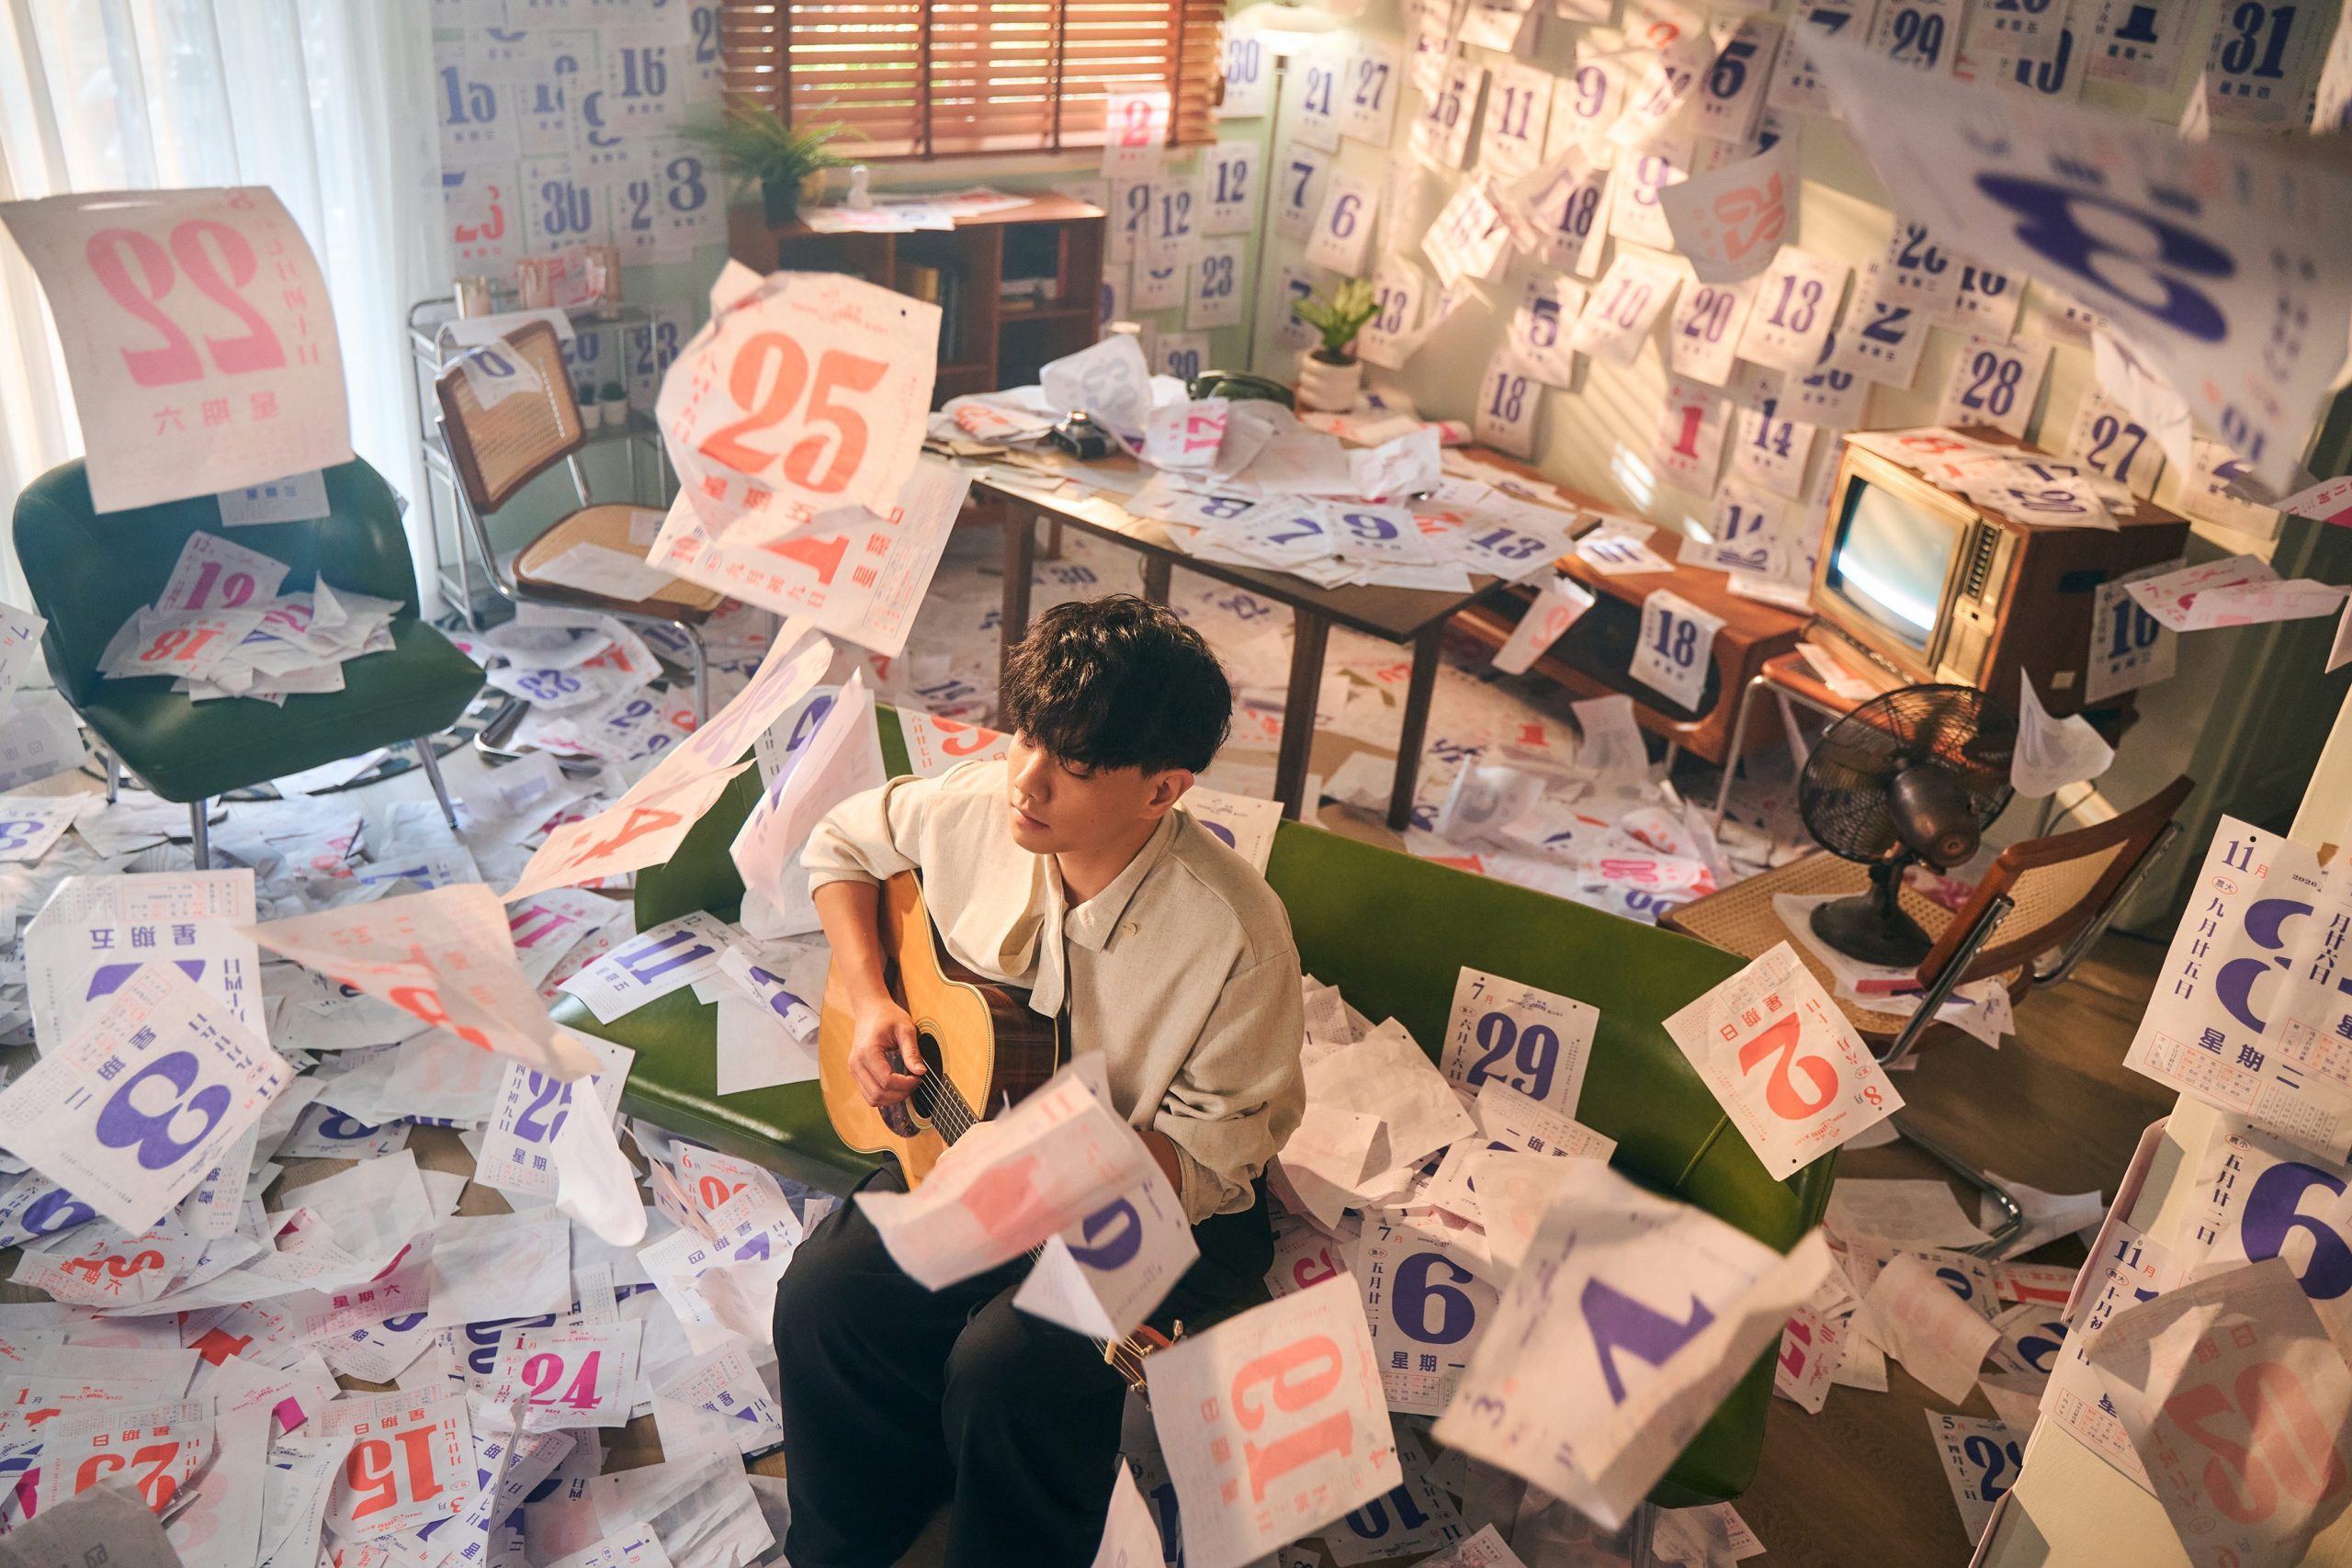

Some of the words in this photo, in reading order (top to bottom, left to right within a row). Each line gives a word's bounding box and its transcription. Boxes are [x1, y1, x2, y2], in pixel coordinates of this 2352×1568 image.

[691, 7, 721, 63] 2
[1889, 7, 1944, 69] 29
[2222, 2, 2296, 79] 31
[1227, 39, 1259, 84] 30
[1356, 60, 1389, 111] 27
[1710, 41, 1756, 99] 5
[1306, 68, 1332, 115] 21
[1499, 87, 1533, 141] 11
[1577, 66, 1606, 117] 9
[1122, 101, 1152, 148] 2
[1216, 161, 1247, 203] 12
[1291, 162, 1314, 207] 7
[1634, 156, 1669, 206] 9
[1161, 191, 1191, 238] 12
[1330, 193, 1363, 238] 6
[1559, 187, 1598, 236] 18
[1201, 255, 1233, 299] 23
[1374, 288, 1406, 333] 13
[1530, 299, 1560, 346] 5
[1602, 279, 1652, 330] 10
[1685, 288, 1735, 342] 20
[1769, 276, 1824, 333] 13
[1490, 374, 1526, 423] 18
[1962, 352, 2023, 416] 28
[697, 332, 889, 495] 25
[1672, 405, 1704, 459] 1
[1755, 398, 1792, 457] 14
[2087, 415, 2147, 482] 27
[1267, 518, 1324, 545] 7
[1342, 513, 1398, 540] 9
[1472, 528, 1546, 560] 13
[184, 561, 254, 610] 19
[140, 627, 224, 662] 18
[1655, 610, 1698, 667] 18
[2222, 840, 2269, 878] 11月
[2291, 874, 2318, 888] 2026
[90, 924, 198, 950] 星期五
[614, 931, 715, 986] 11
[2175, 897, 2224, 999] 九月廿五日
[2309, 912, 2350, 986] 月廿六日
[1472, 983, 1493, 1004] 7月
[1720, 993, 1783, 1042] 星期日
[187, 1011, 254, 1073] 九月廿五日
[1450, 1019, 1472, 1080] 六月十六日
[1467, 1011, 1559, 1101] 29
[1805, 999, 1857, 1066] 六月十日
[64, 1025, 157, 1111] 星期二
[1738, 1011, 1838, 1121] 2
[2198, 1027, 2304, 1090] 星期二
[96, 1052, 232, 1170] 3
[243, 1076, 279, 1109] 11月
[500, 1064, 526, 1132] 四月初九日
[1854, 1085, 1883, 1105] 8月
[512, 1147, 547, 1171] 星期
[2197, 1154, 2242, 1247] 五月廿二日
[688, 1221, 753, 1264] 星期四
[1378, 1226, 1402, 1243] 7月
[2242, 1162, 2352, 1299] 6
[60, 1261, 122, 1295] 星期六
[2114, 1240, 2156, 1279] 11月
[332, 1284, 401, 1308] 星期六
[1368, 1262, 1384, 1337] 五月廿二日
[1392, 1252, 1476, 1344] 6
[2077, 1287, 2120, 1366] 十月初日
[513, 1350, 603, 1409] 24
[1391, 1351, 1465, 1372] 星期一
[15, 1388, 43, 1404] 1月
[93, 1426, 170, 1447] 星期日
[354, 1408, 425, 1435] 星期日
[1942, 1416, 1965, 1430] 5月
[346, 1424, 445, 1520] 15
[1964, 1435, 2023, 1503] 2
[437, 1497, 465, 1513] 3月
